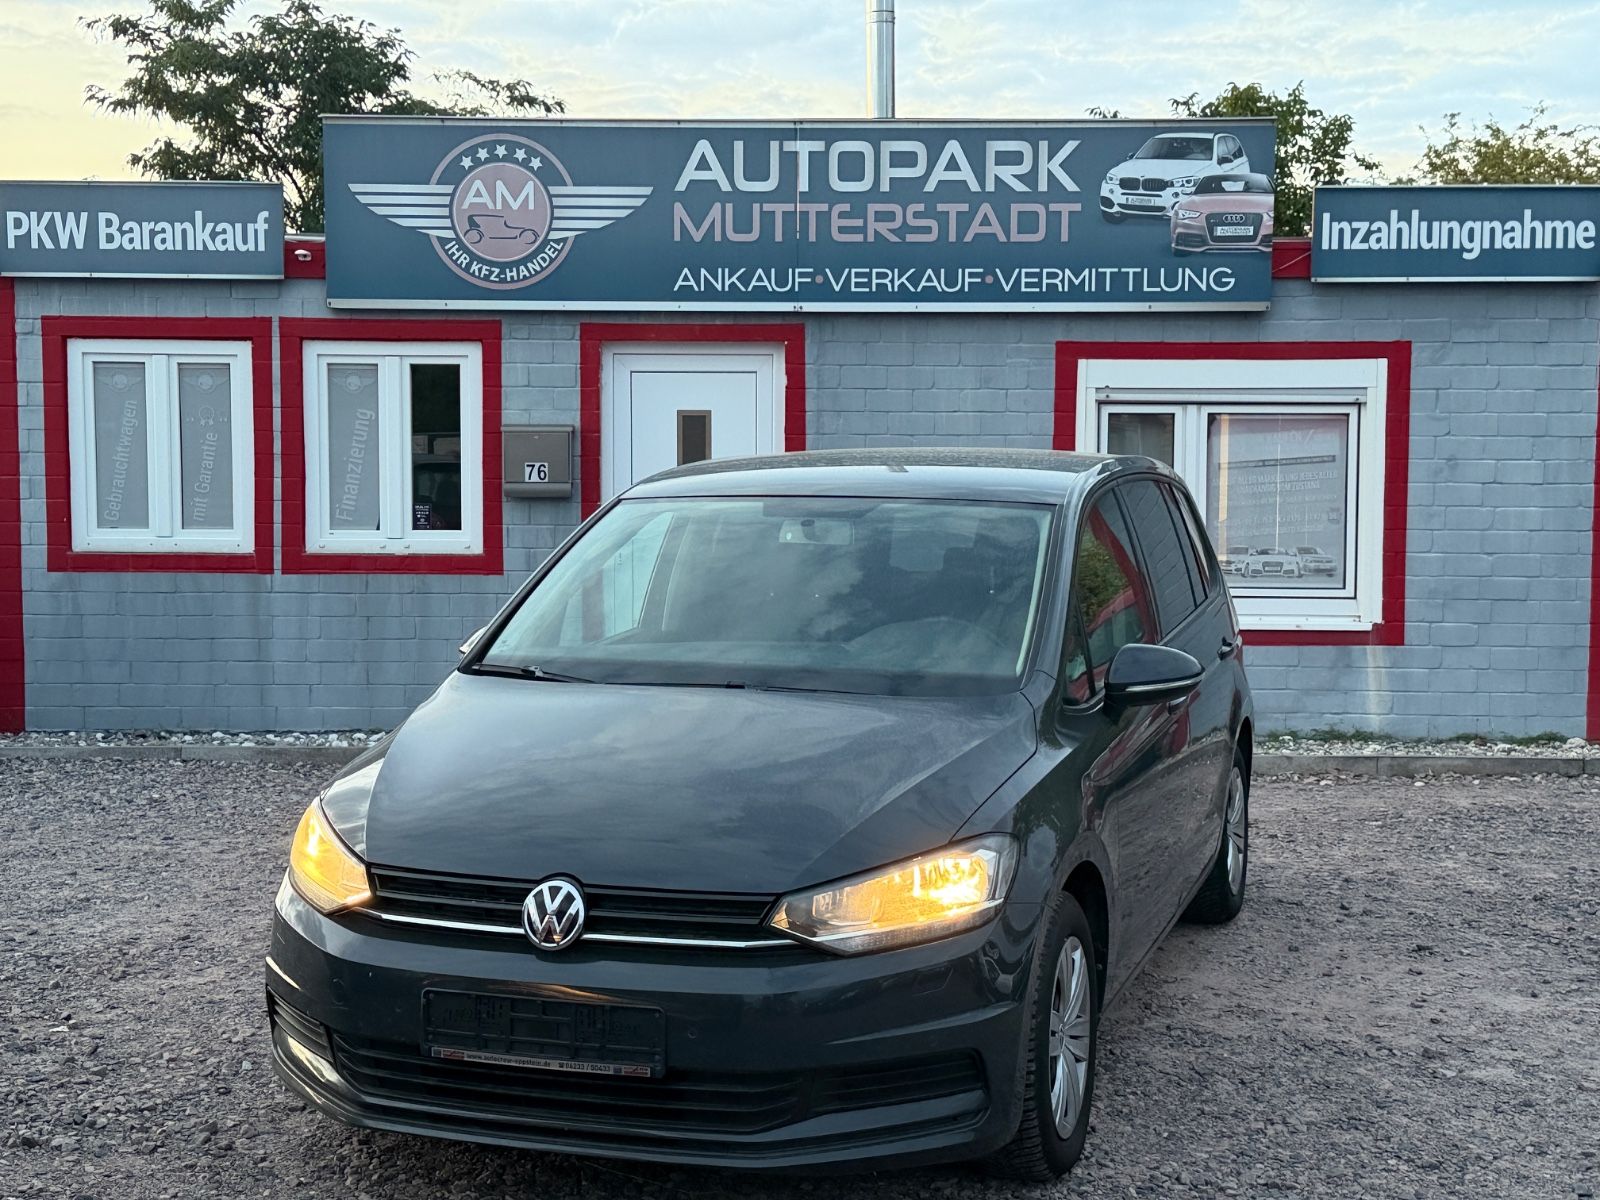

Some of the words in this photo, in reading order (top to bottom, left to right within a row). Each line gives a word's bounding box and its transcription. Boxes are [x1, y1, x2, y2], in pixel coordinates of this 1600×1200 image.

[674, 139, 1081, 192] AUTOPARK
[461, 179, 535, 211] AM
[6, 211, 88, 249] PKW
[98, 210, 269, 251] Barankauf
[673, 201, 1082, 243] MUTTERSTADT
[1321, 209, 1596, 260] Inzahlungnahme
[444, 240, 470, 268] IHR
[469, 241, 564, 281] KFZ-HANDEL
[673, 267, 814, 292] ANKAUF
[825, 267, 984, 292] VERKAUF
[995, 267, 1236, 293] VERMITTLUNG
[103, 400, 139, 521] Gebrauchtwagen
[194, 431, 218, 493] Garantie
[336, 408, 376, 521] Finanzierung
[526, 463, 547, 481] 76
[191, 497, 208, 521] mit
